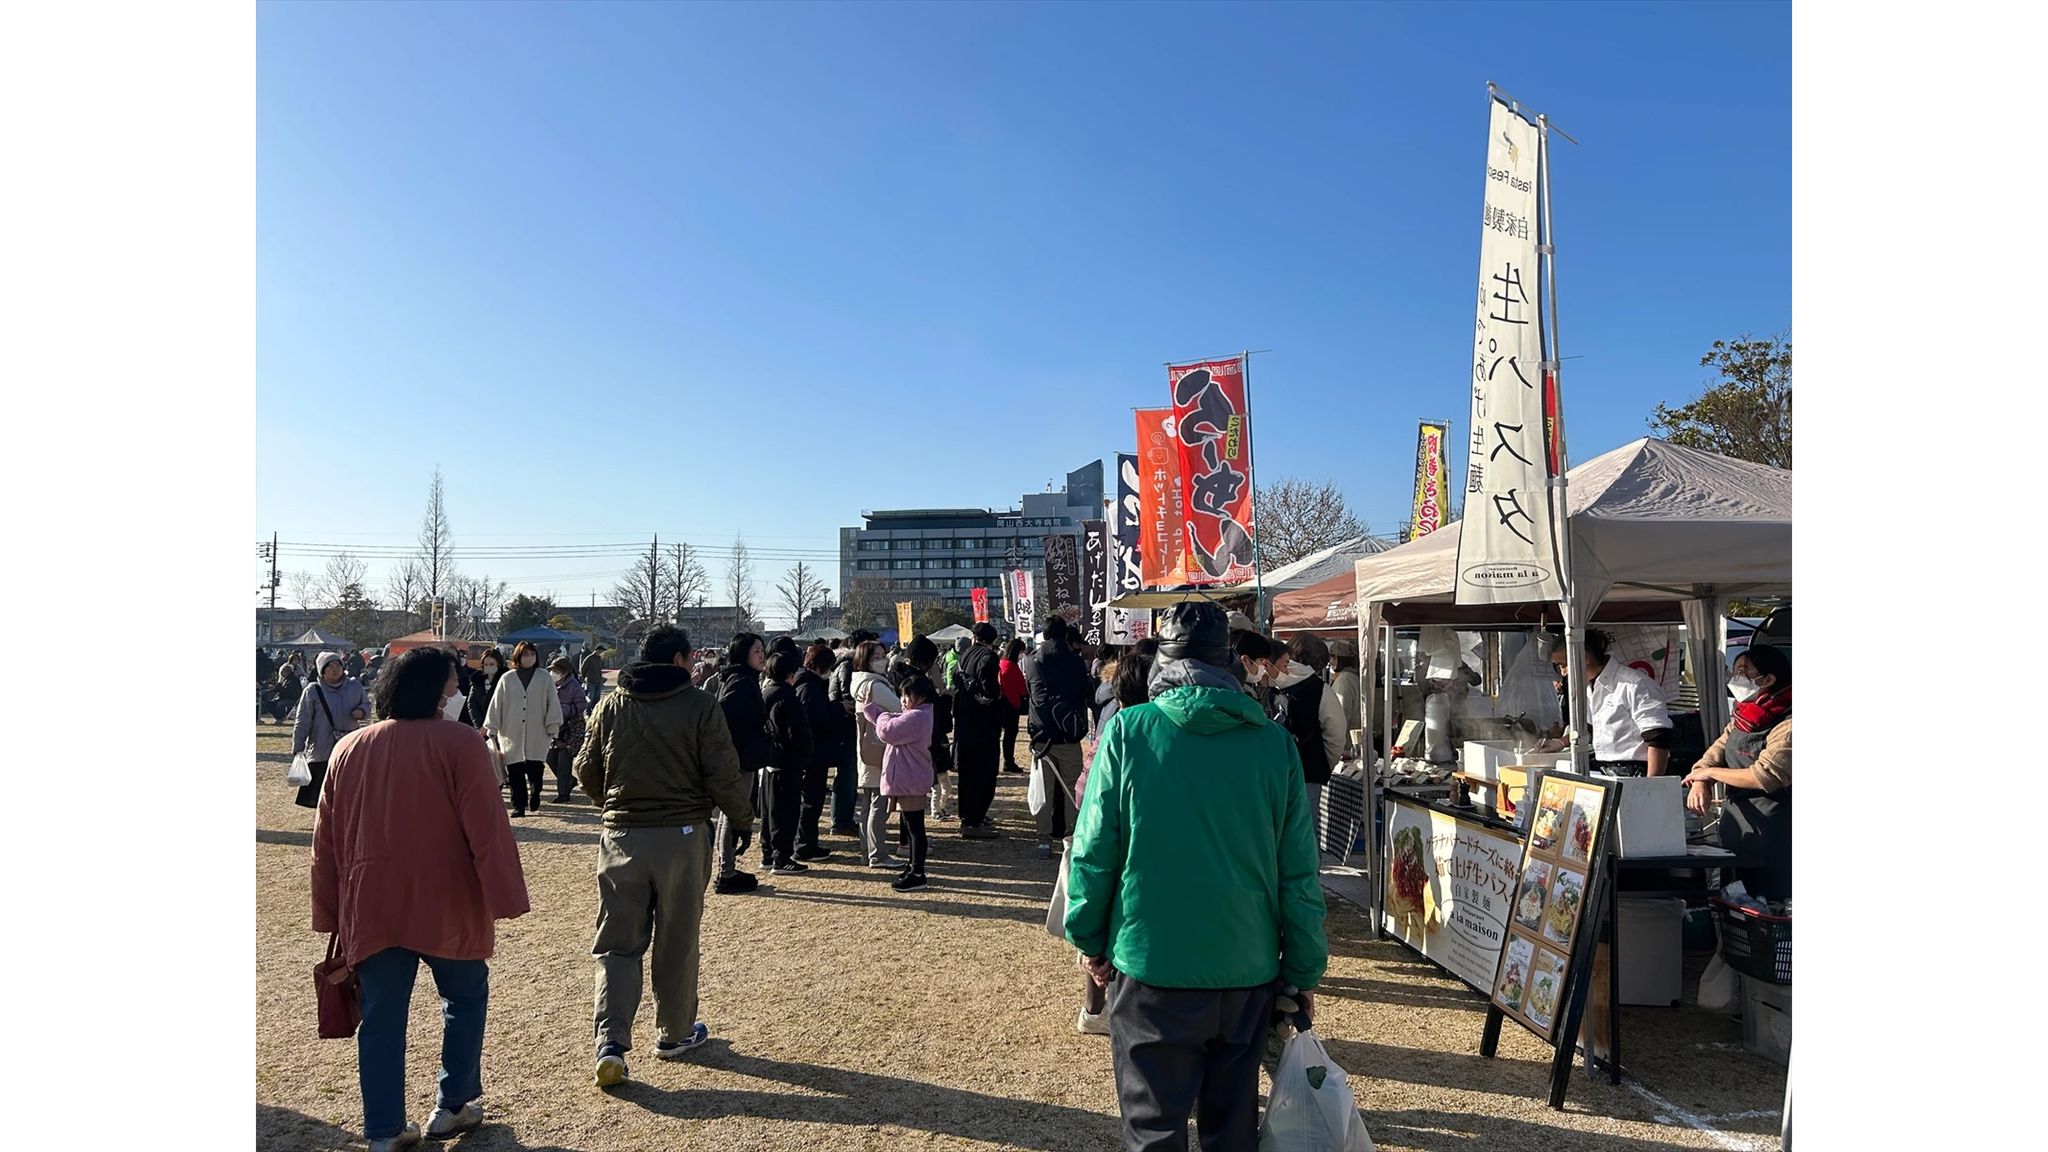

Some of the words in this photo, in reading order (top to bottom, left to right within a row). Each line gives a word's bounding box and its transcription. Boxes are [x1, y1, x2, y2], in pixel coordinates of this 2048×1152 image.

[996, 519, 1061, 527] 岡山西大寺病院
[1085, 531, 1105, 646] あげだし豆腐
[1434, 856, 1514, 903] 茹で上げ生パス
[1457, 910, 1464, 924] la
[1464, 918, 1499, 941] maison
